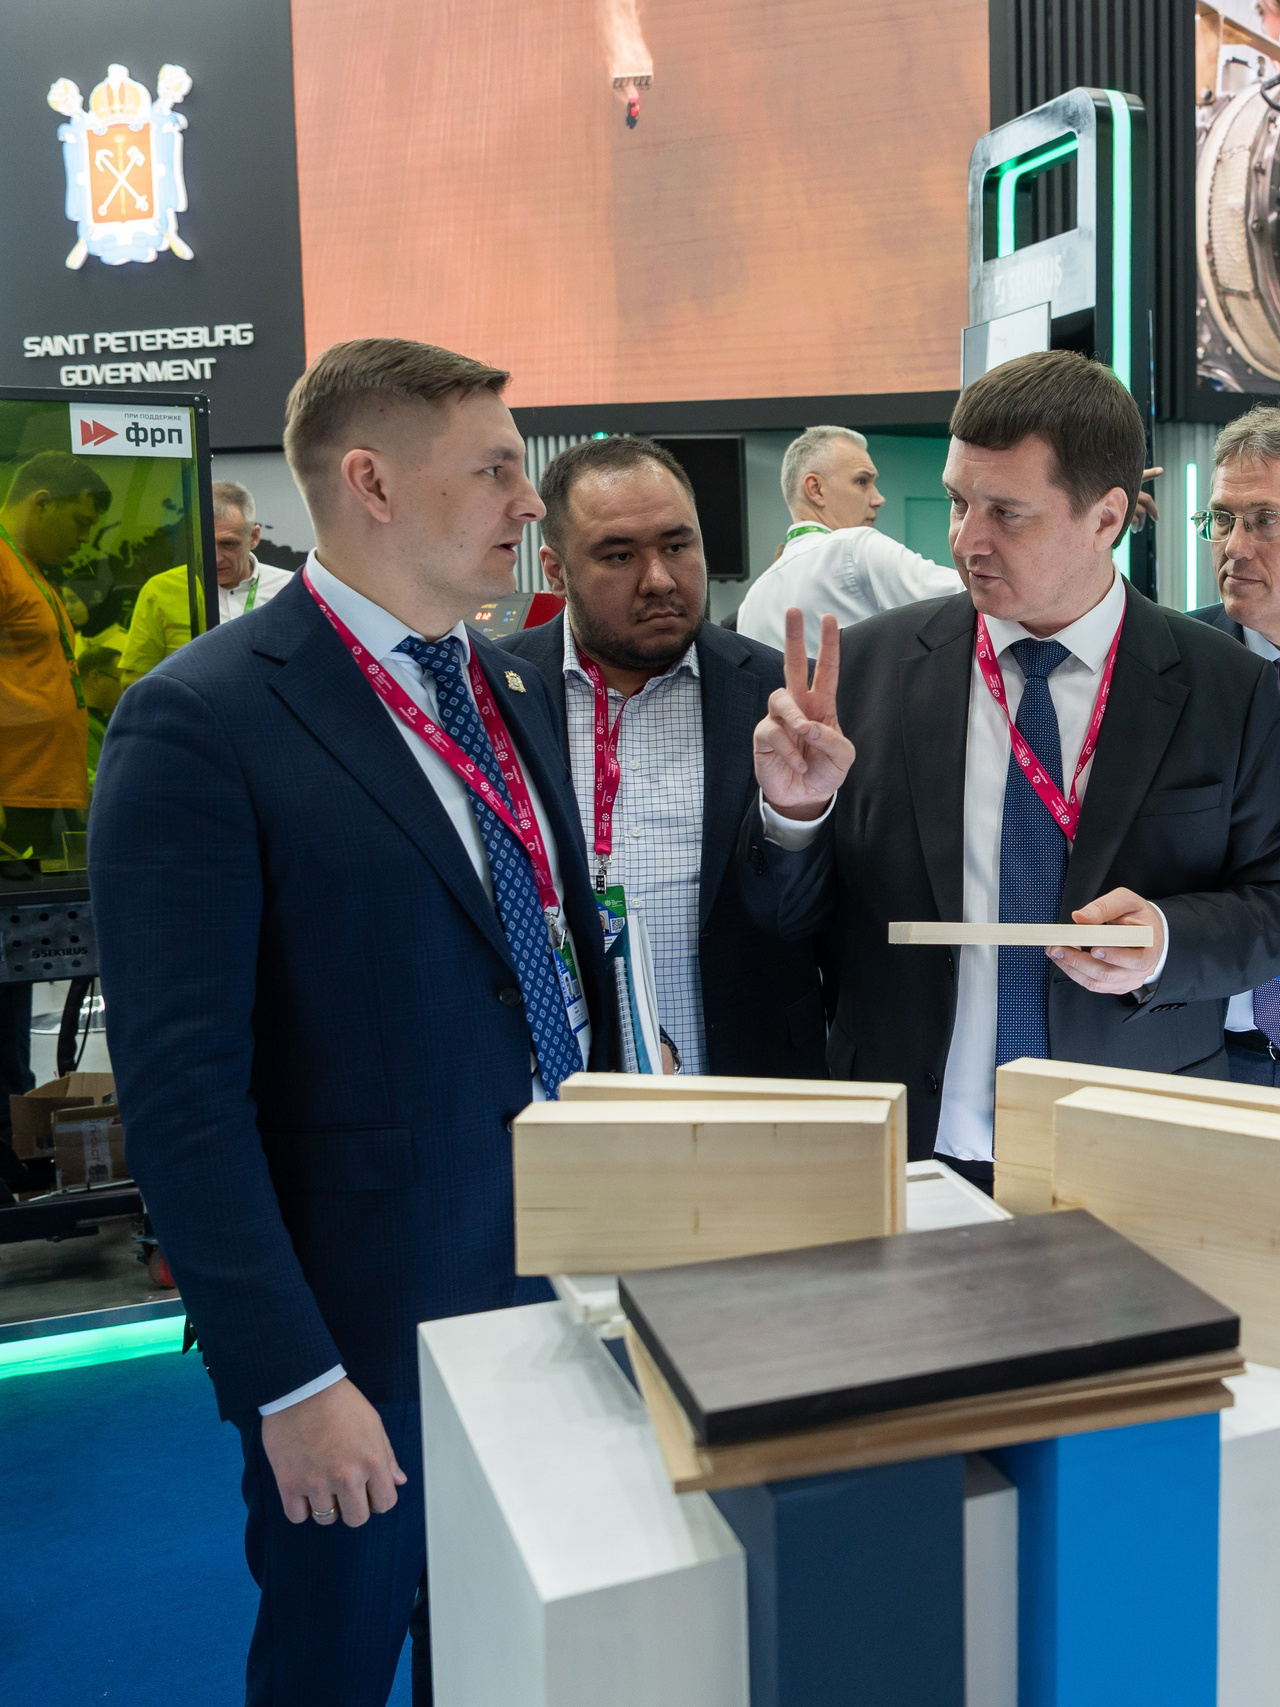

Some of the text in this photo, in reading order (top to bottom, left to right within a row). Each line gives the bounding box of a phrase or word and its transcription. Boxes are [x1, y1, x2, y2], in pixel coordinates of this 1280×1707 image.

[23, 323, 254, 358] SAINT PETERSBURG
[60, 357, 217, 387] GOVERNMENT
[140, 413, 182, 421] ПОДДЕРЖКЕ
[125, 421, 183, 447] фрп
[42, 946, 88, 957] SEKIRUS
